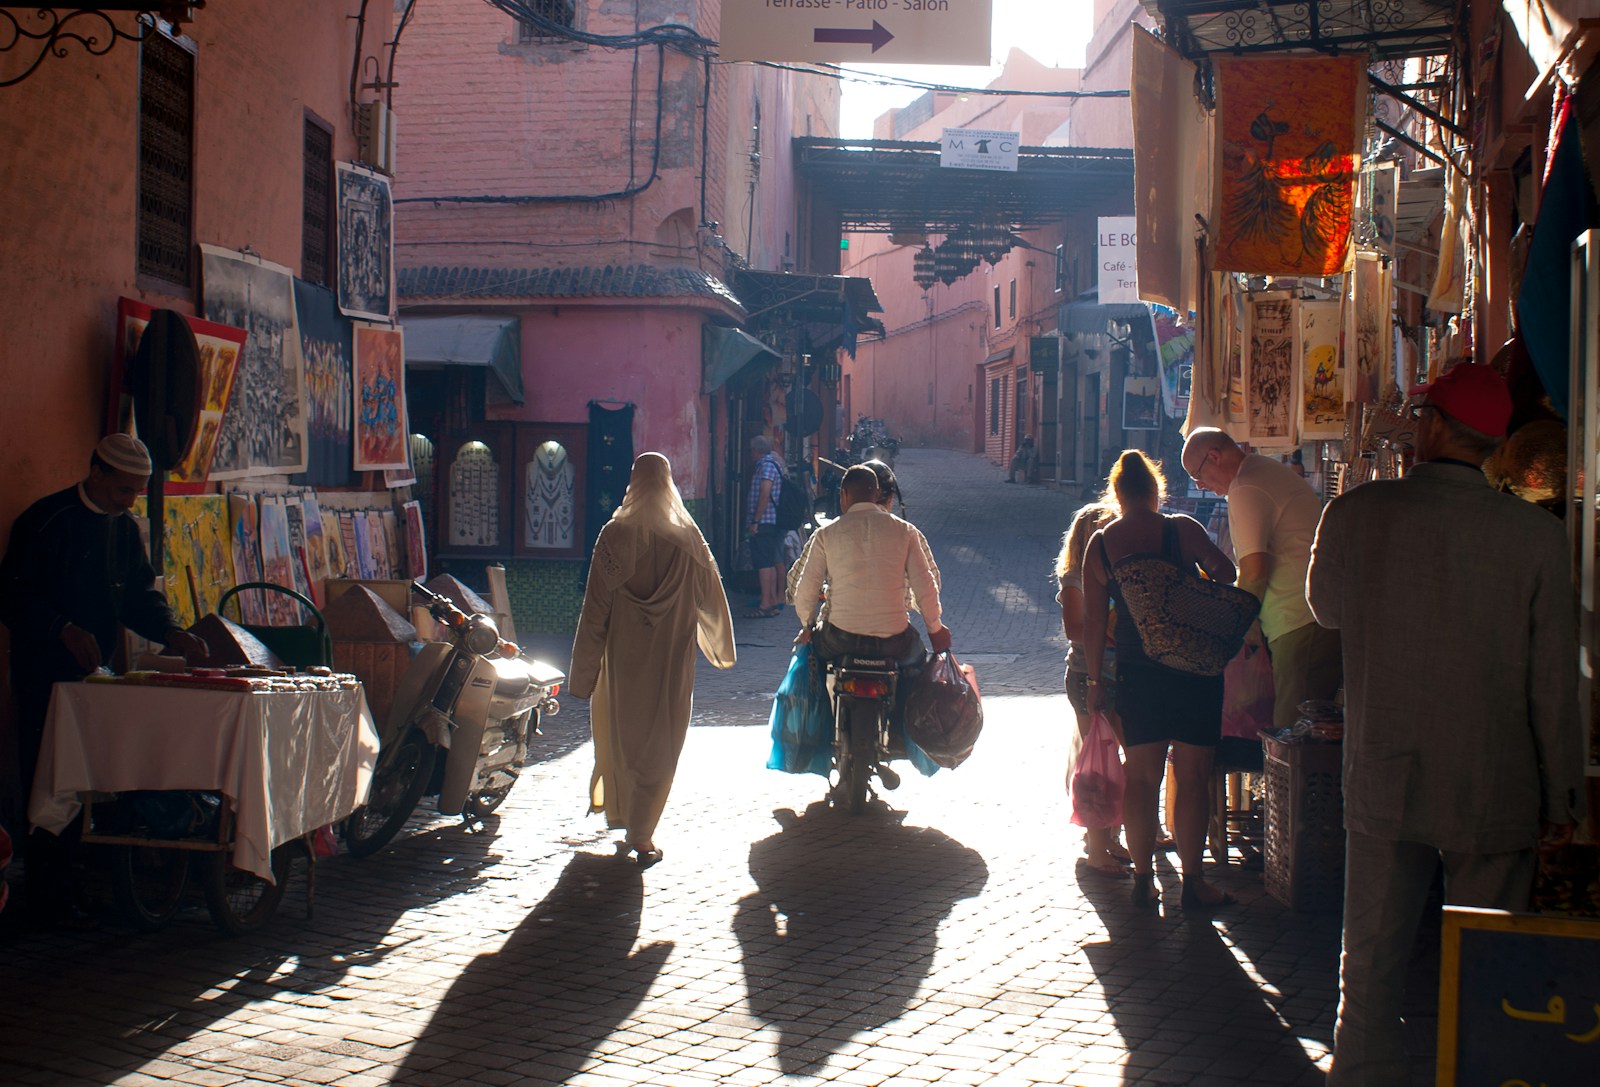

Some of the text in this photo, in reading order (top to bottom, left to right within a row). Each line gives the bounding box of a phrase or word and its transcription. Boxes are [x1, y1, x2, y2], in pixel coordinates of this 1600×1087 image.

[903, 0, 948, 11] Salon
[949, 139, 1012, 152] M C
[1100, 233, 1116, 247] LE
[1103, 261, 1126, 271] Café
[853, 657, 886, 666] DOCKER
